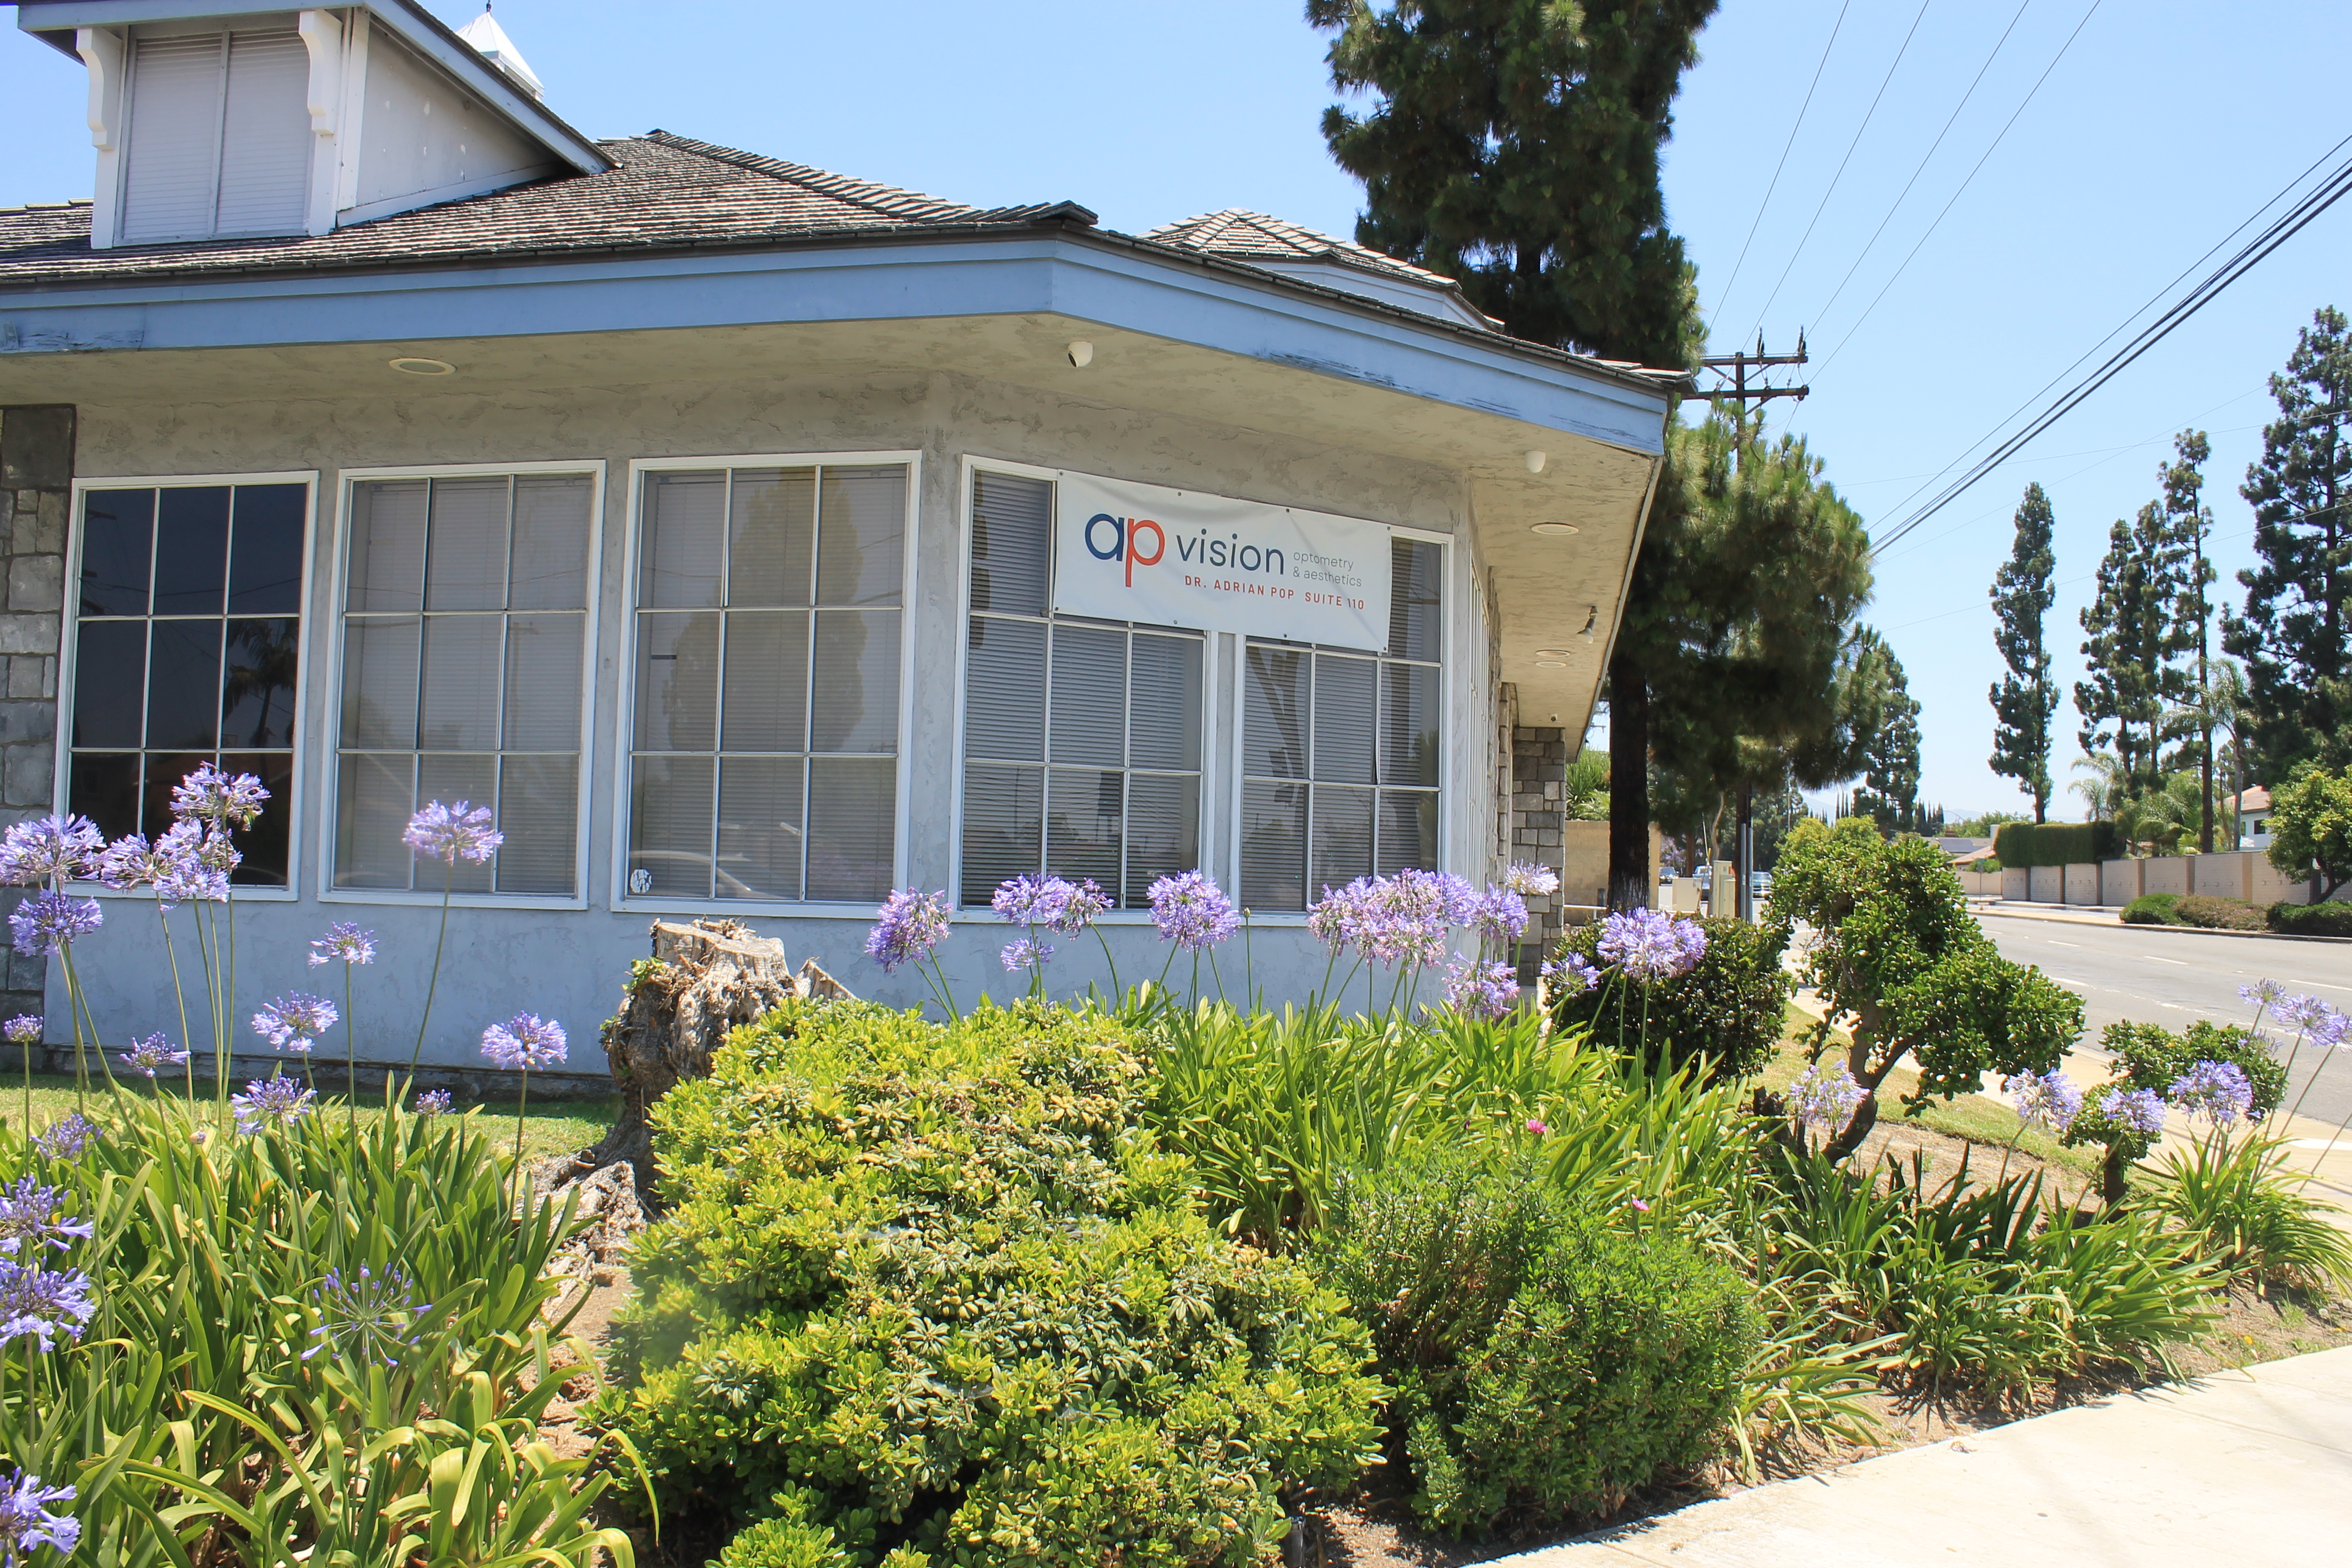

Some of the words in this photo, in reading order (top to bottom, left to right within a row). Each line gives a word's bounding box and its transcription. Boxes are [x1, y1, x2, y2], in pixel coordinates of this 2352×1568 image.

[1085, 513, 1165, 587] ap
[1176, 528, 1284, 575] vision
[1293, 552, 1354, 572] optometry
[1293, 566, 1300, 578] &
[1304, 570, 1362, 587] aesthetics
[1185, 575, 1207, 588] DR.
[1214, 579, 1265, 596] ADRIAN
[1271, 587, 1294, 599] POP
[1305, 592, 1342, 606] SUITE
[1347, 598, 1364, 610] 110
